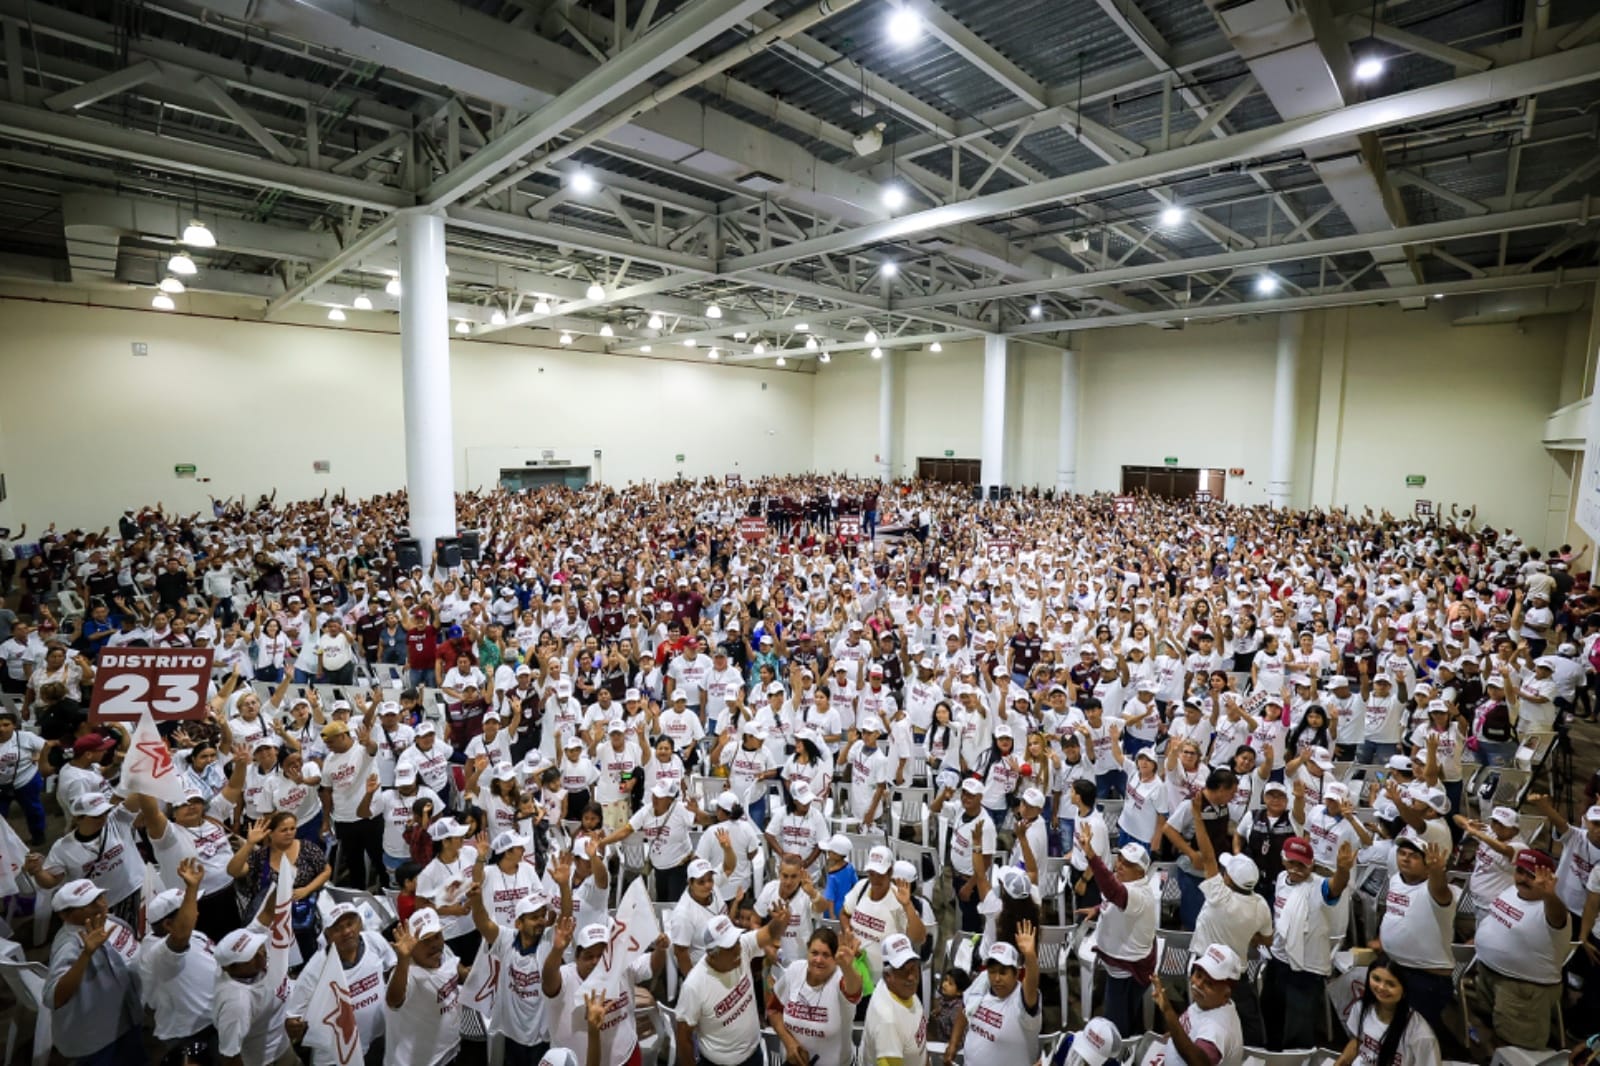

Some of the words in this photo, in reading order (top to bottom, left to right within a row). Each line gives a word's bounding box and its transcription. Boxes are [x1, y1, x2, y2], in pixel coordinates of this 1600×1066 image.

[1116, 503, 1134, 512] 21
[841, 523, 859, 535] 23
[101, 655, 207, 669] DISTRITO
[97, 673, 199, 714] 23
[722, 994, 753, 1027] morena
[600, 1012, 628, 1031] orena
